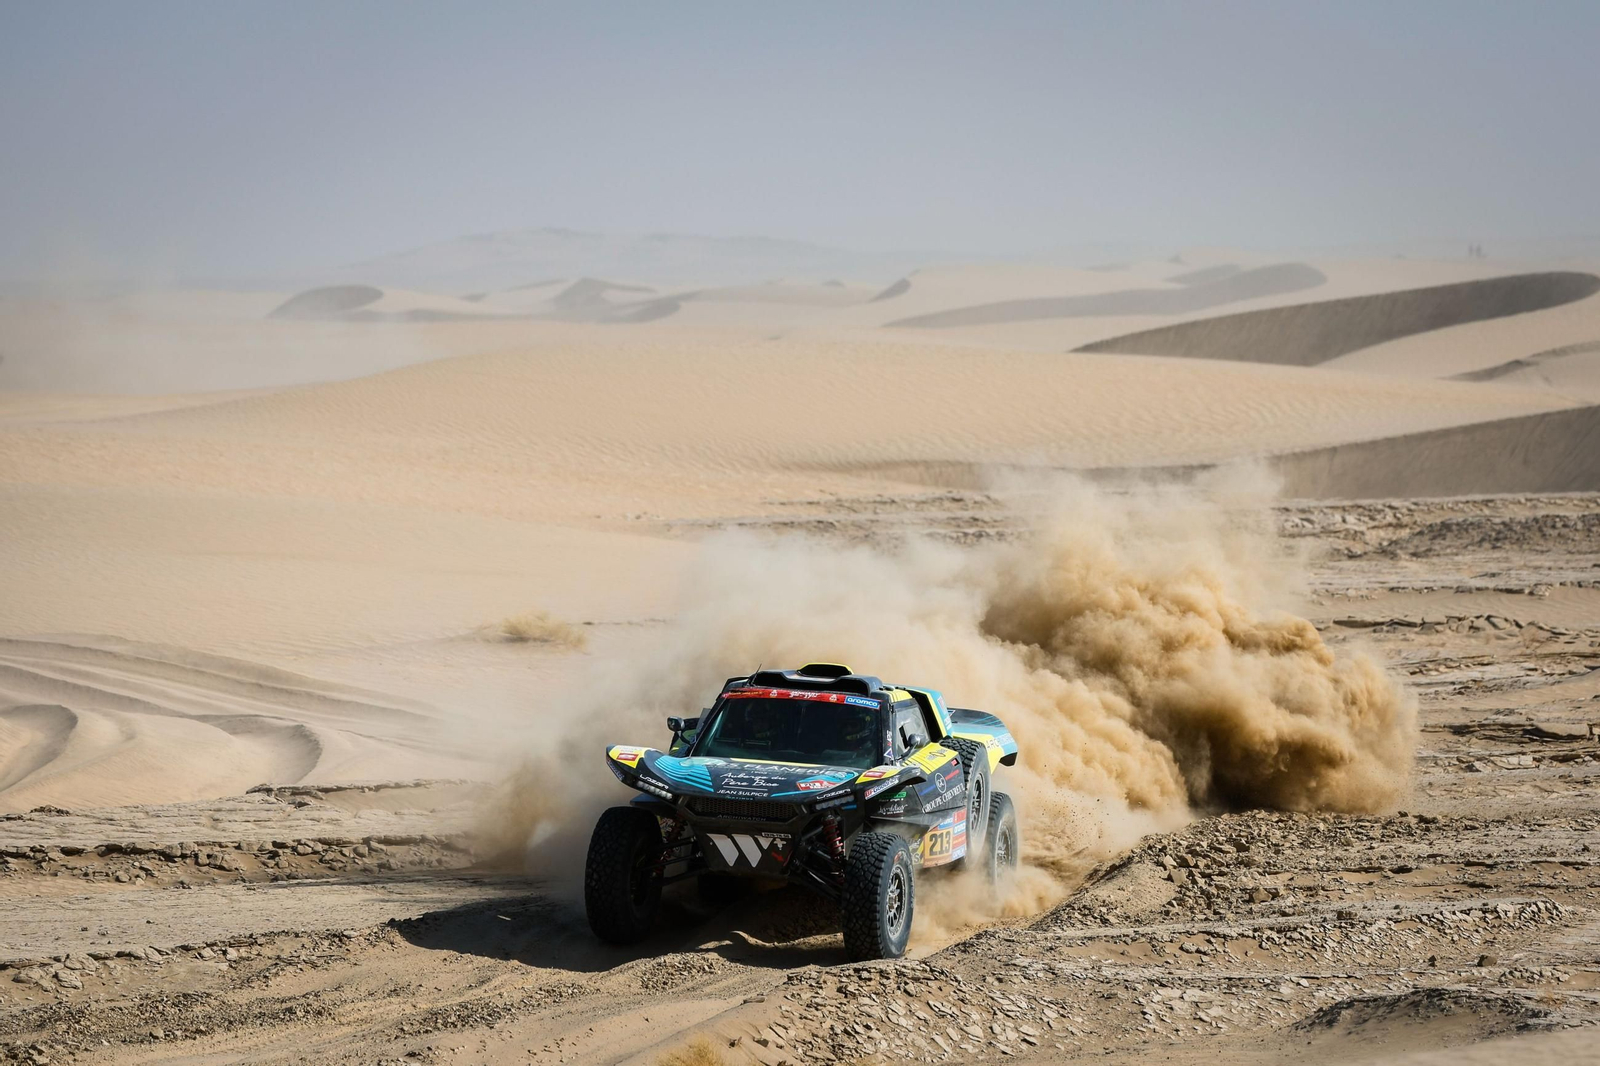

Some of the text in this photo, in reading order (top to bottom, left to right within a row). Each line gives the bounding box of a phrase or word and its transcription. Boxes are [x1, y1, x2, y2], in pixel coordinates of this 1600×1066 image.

[847, 697, 878, 707] aramco
[720, 772, 768, 780] Auberge
[738, 790, 769, 798] SULPICE
[929, 829, 951, 857] 213
